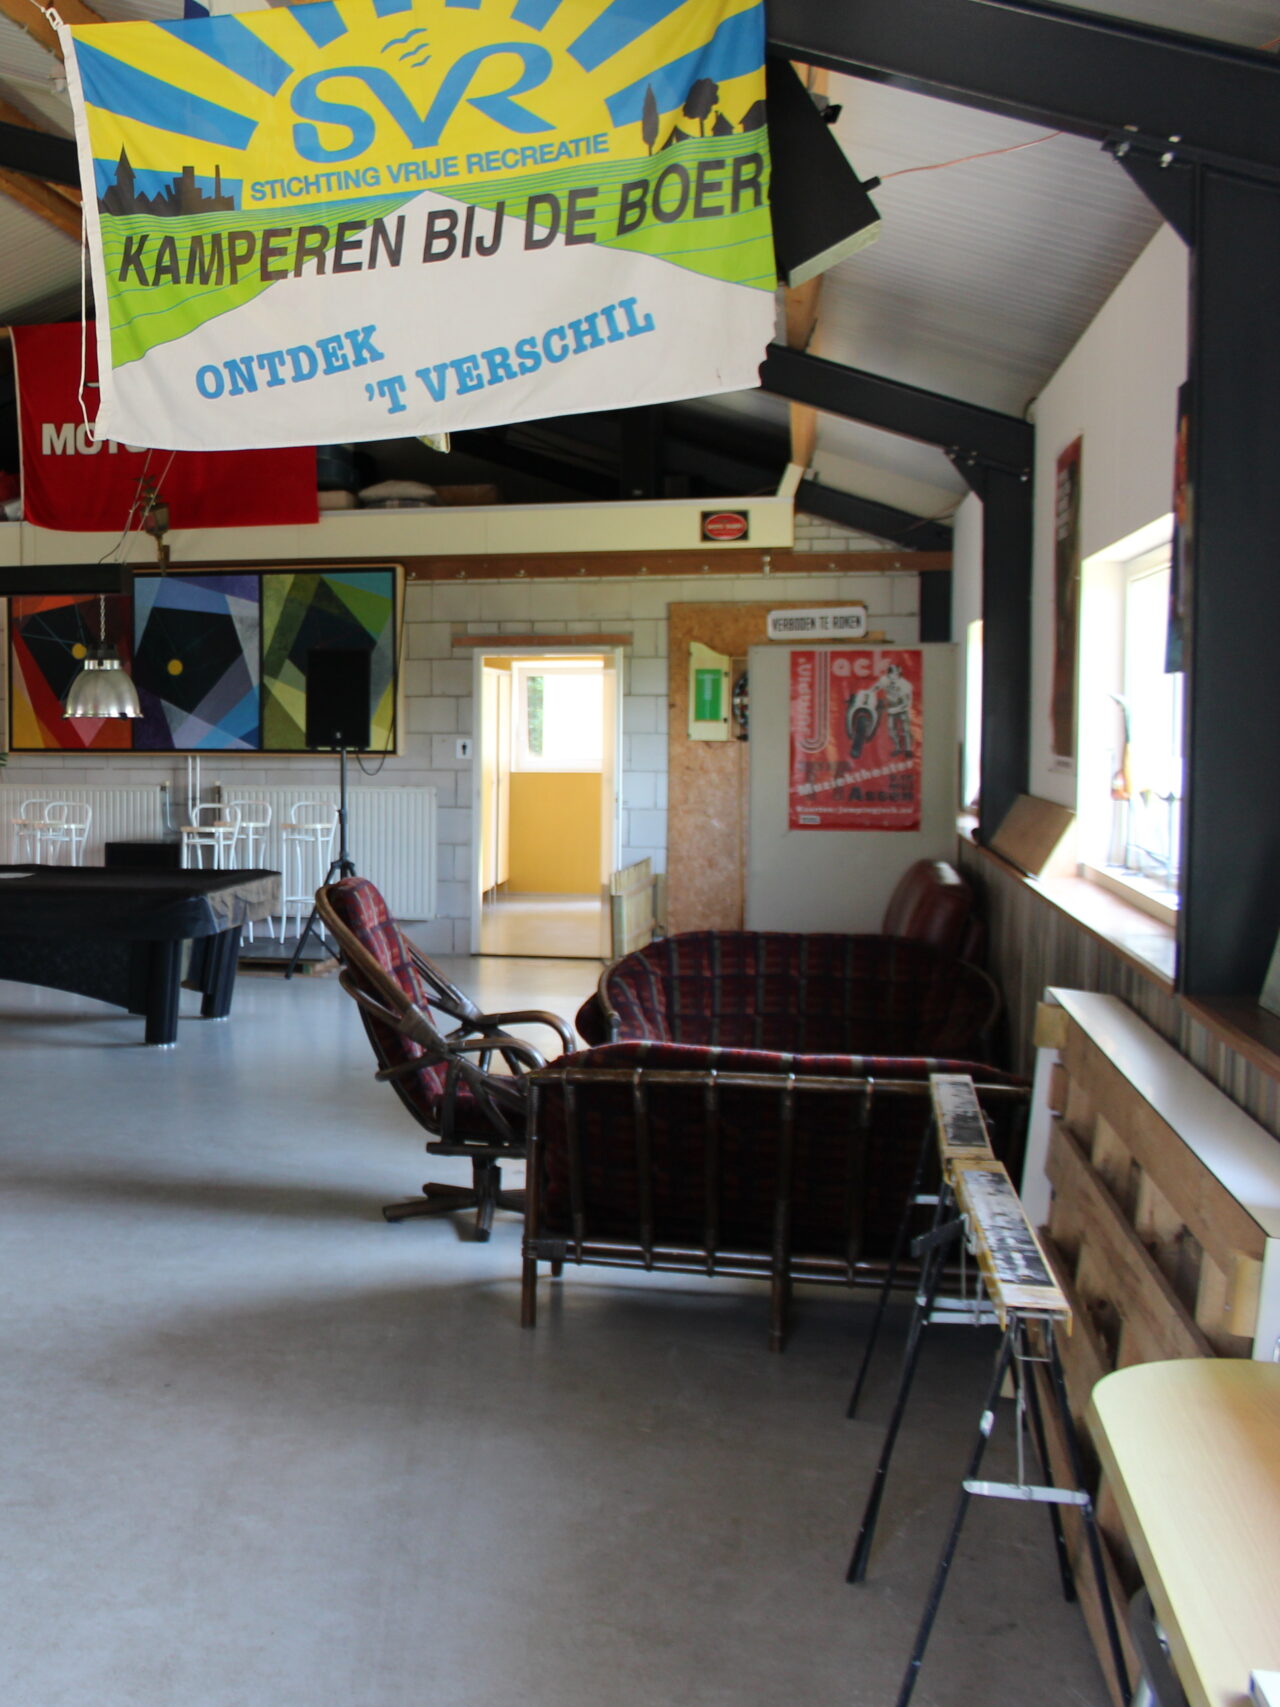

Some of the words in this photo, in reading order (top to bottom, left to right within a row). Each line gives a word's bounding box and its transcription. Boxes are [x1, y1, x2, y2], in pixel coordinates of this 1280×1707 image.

[290, 42, 556, 164] SVR
[250, 164, 383, 202] STICHTING
[385, 156, 463, 185] VRIJE
[465, 131, 610, 176] RECREATIE
[119, 214, 405, 287] KAMPEREN
[421, 205, 505, 263] BIJ
[523, 187, 598, 250] DE
[616, 152, 764, 237] BOER
[195, 324, 385, 400] ONTDEK
[416, 296, 656, 404] VERSCHIL
[772, 616, 816, 632] VERBODEN
[819, 615, 829, 630] TE
[833, 615, 861, 630] ROKEN
[796, 759, 915, 797] Muziektheater
